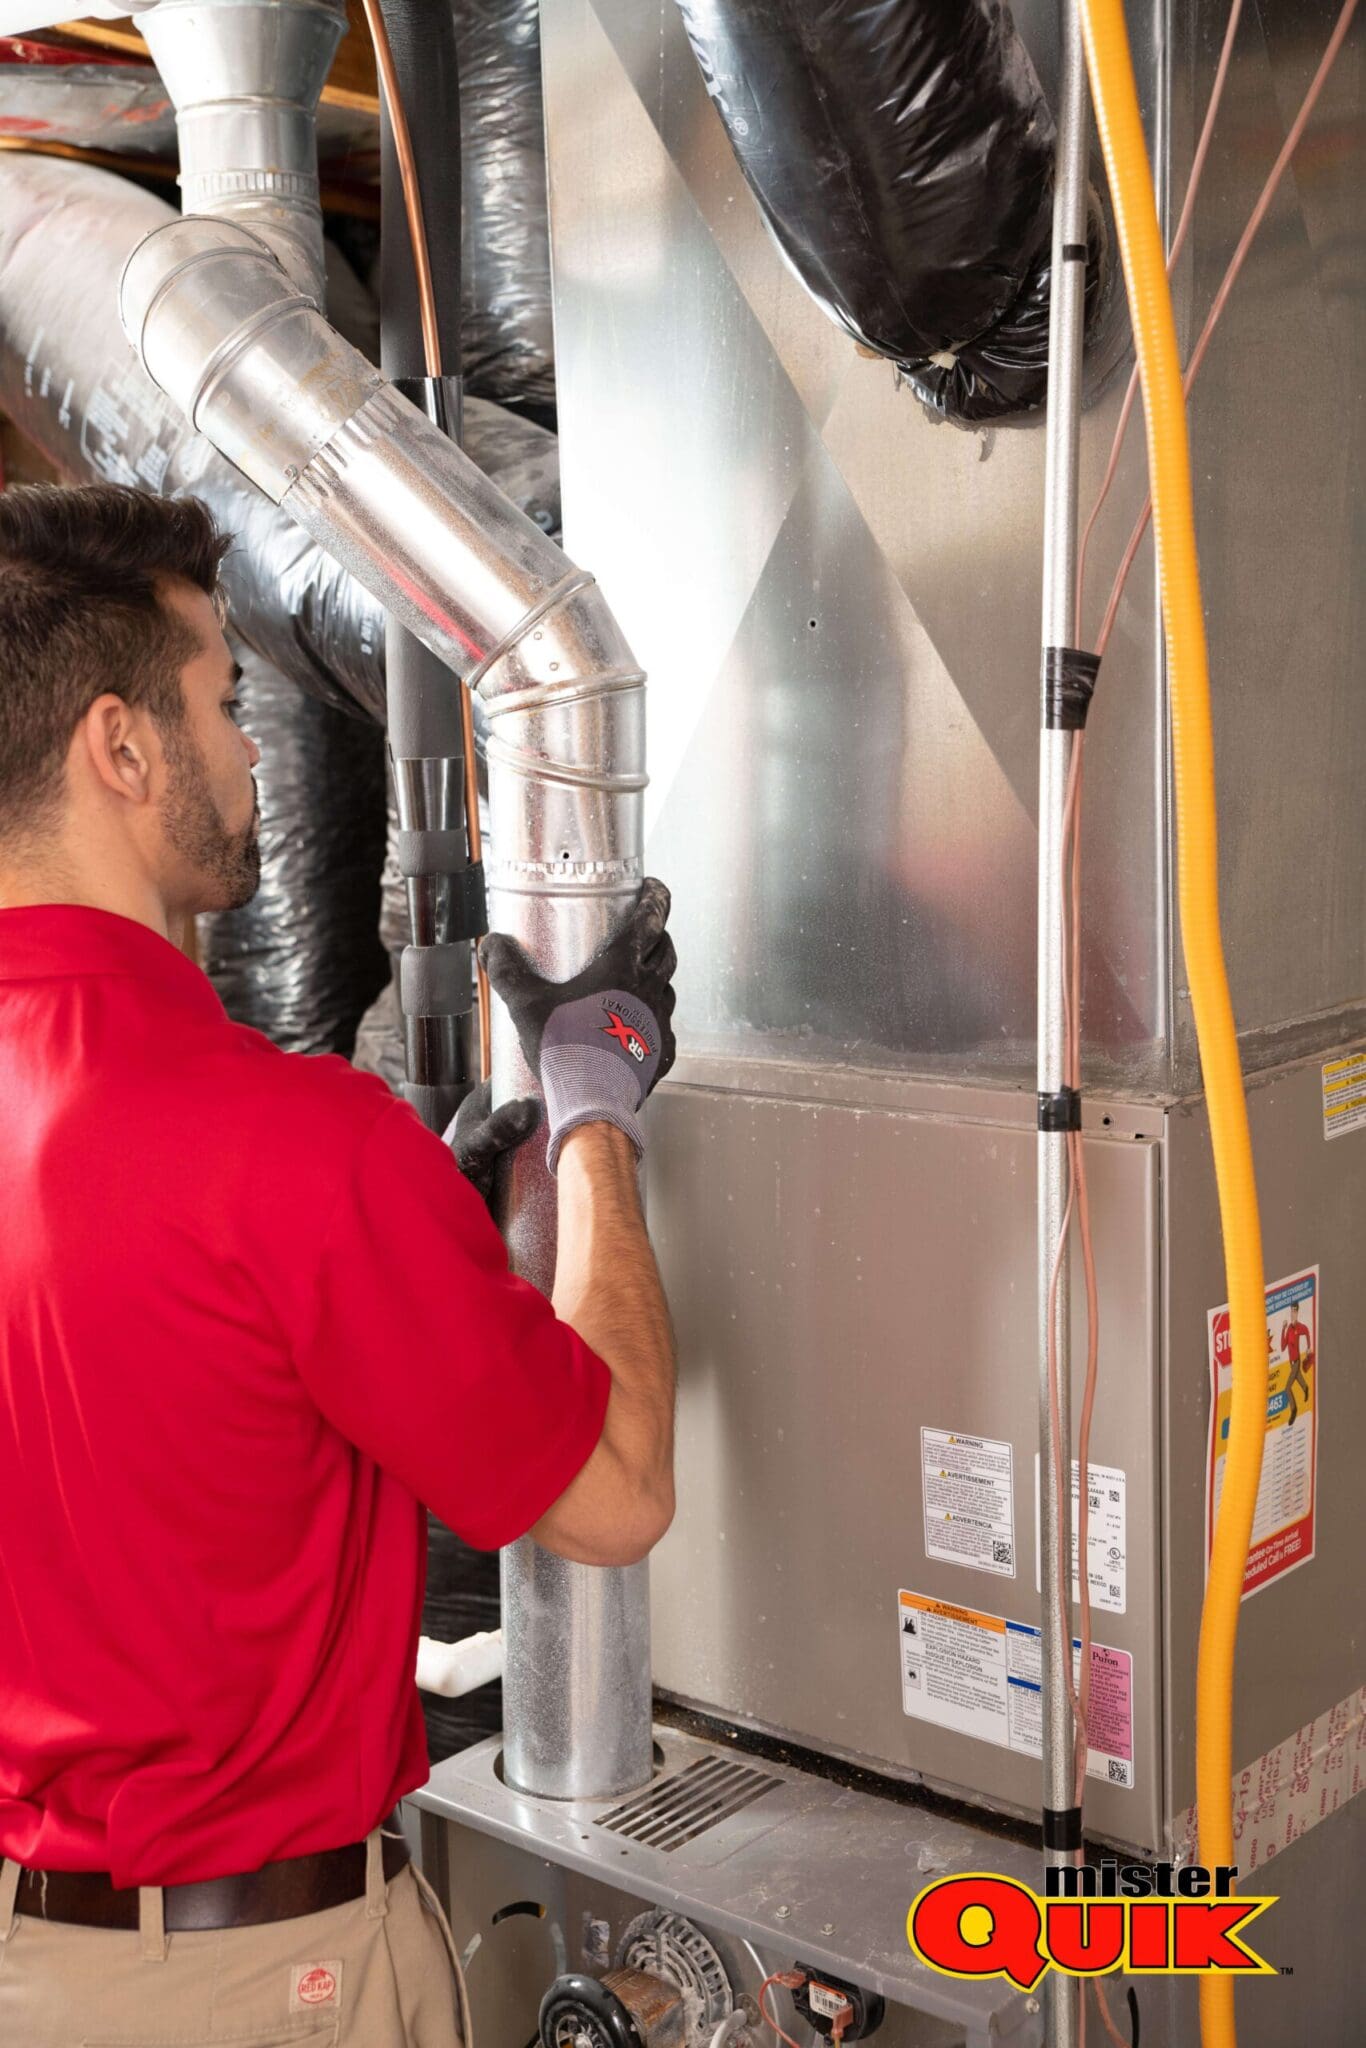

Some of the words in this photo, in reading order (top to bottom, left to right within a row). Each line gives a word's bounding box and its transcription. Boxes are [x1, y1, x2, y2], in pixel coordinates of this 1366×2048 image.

[956, 1438, 984, 1449] WARNING
[947, 1471, 995, 1487] AVERTISSEMENT
[952, 1514, 993, 1530] ADVERTENCIA
[1092, 1651, 1119, 1667] Puron
[301, 1983, 317, 1994] RED
[317, 1980, 333, 1991] KAP
